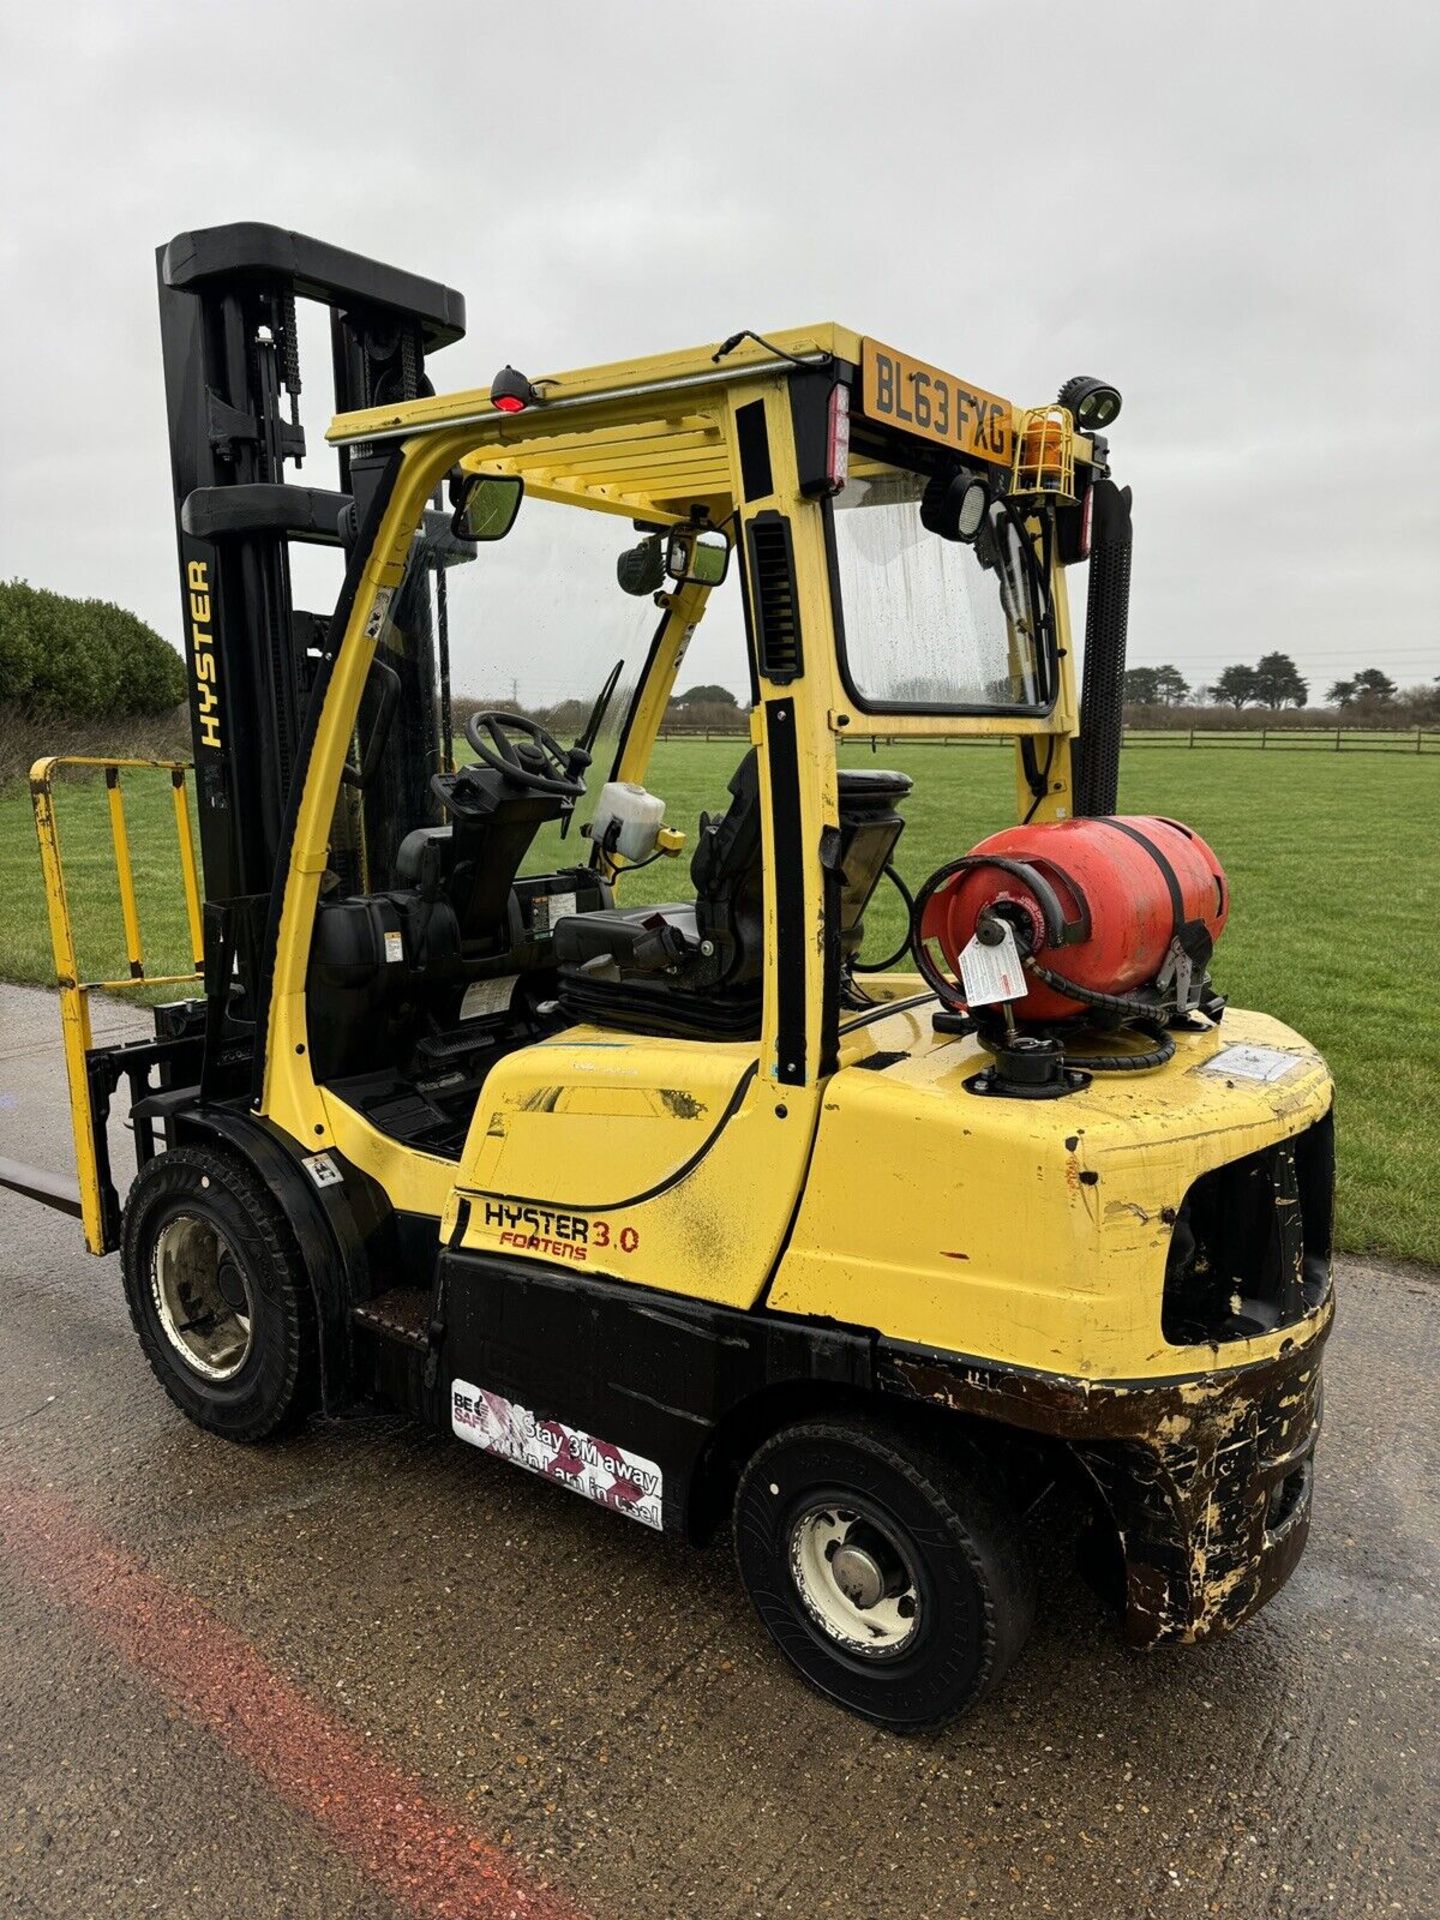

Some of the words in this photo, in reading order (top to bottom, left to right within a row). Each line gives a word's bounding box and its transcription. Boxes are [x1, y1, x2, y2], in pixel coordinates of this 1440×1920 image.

[876, 353, 948, 435] BL63
[957, 389, 1005, 454] FXG
[188, 560, 221, 748] HYSTER
[485, 1202, 588, 1244] HYSTER
[593, 1221, 639, 1253] 3.0
[500, 1231, 587, 1261] FORTENS
[454, 1391, 473, 1413] BE
[522, 1414, 563, 1453] Stay
[569, 1435, 599, 1467] 3M
[604, 1456, 658, 1495] away
[589, 1477, 608, 1502] in
